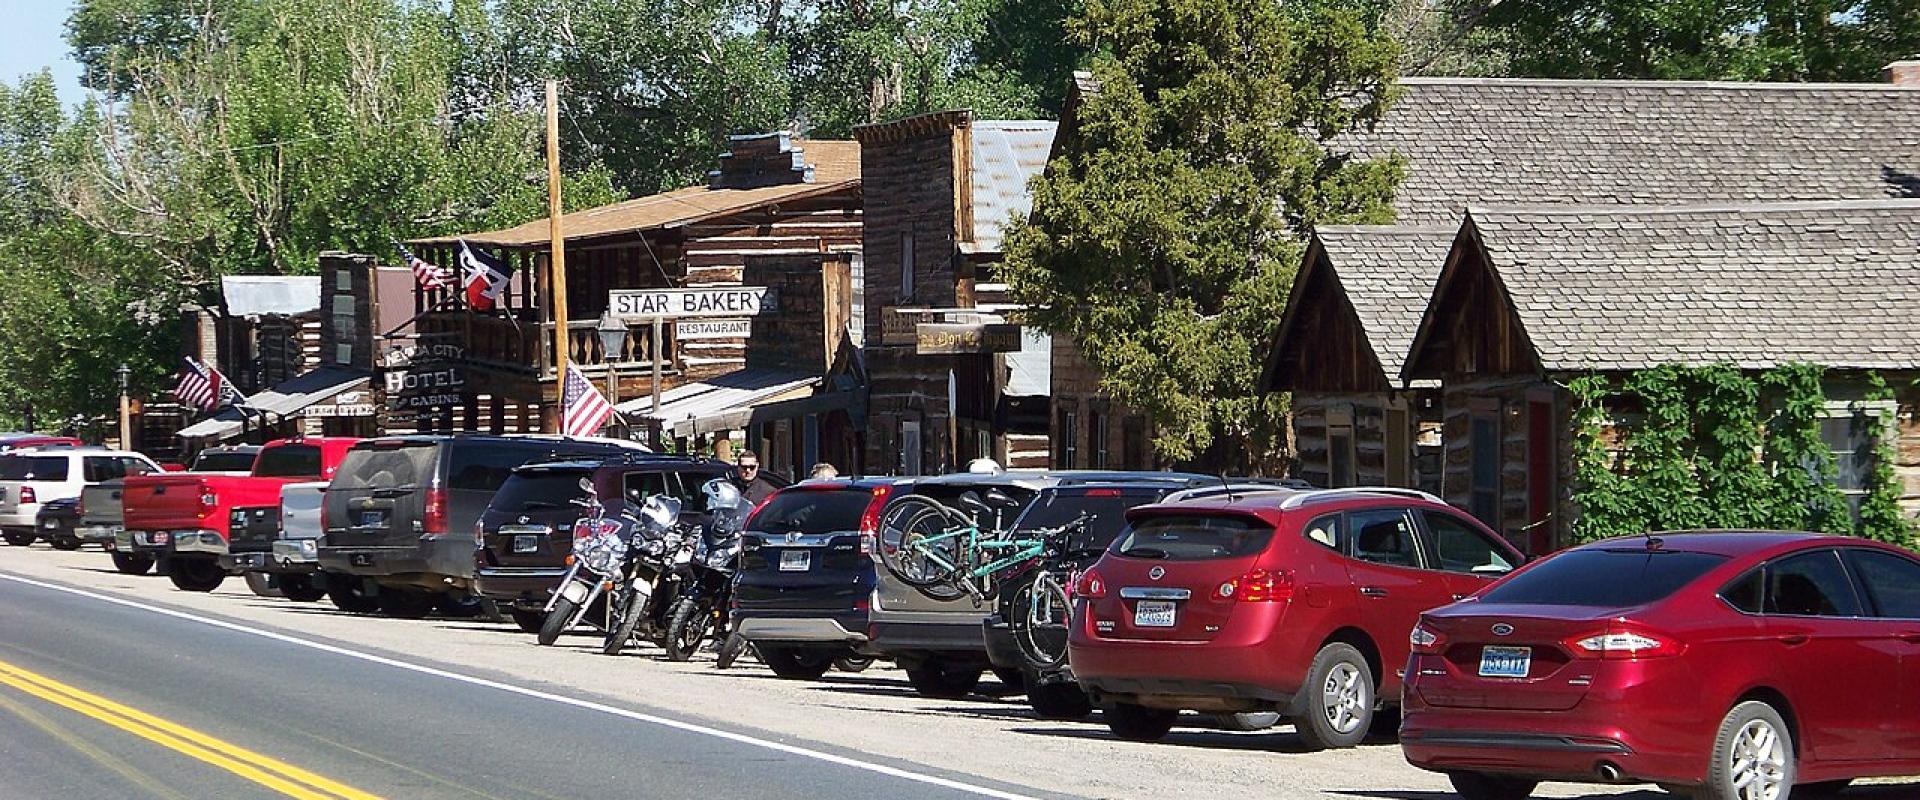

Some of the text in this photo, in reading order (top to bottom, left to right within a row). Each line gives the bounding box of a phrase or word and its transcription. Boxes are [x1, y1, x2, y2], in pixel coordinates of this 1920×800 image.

[618, 292, 763, 313] STAR BAKERY
[679, 322, 748, 334] RESTAURANT
[433, 344, 464, 359] CITY
[385, 368, 464, 393] HOTEL
